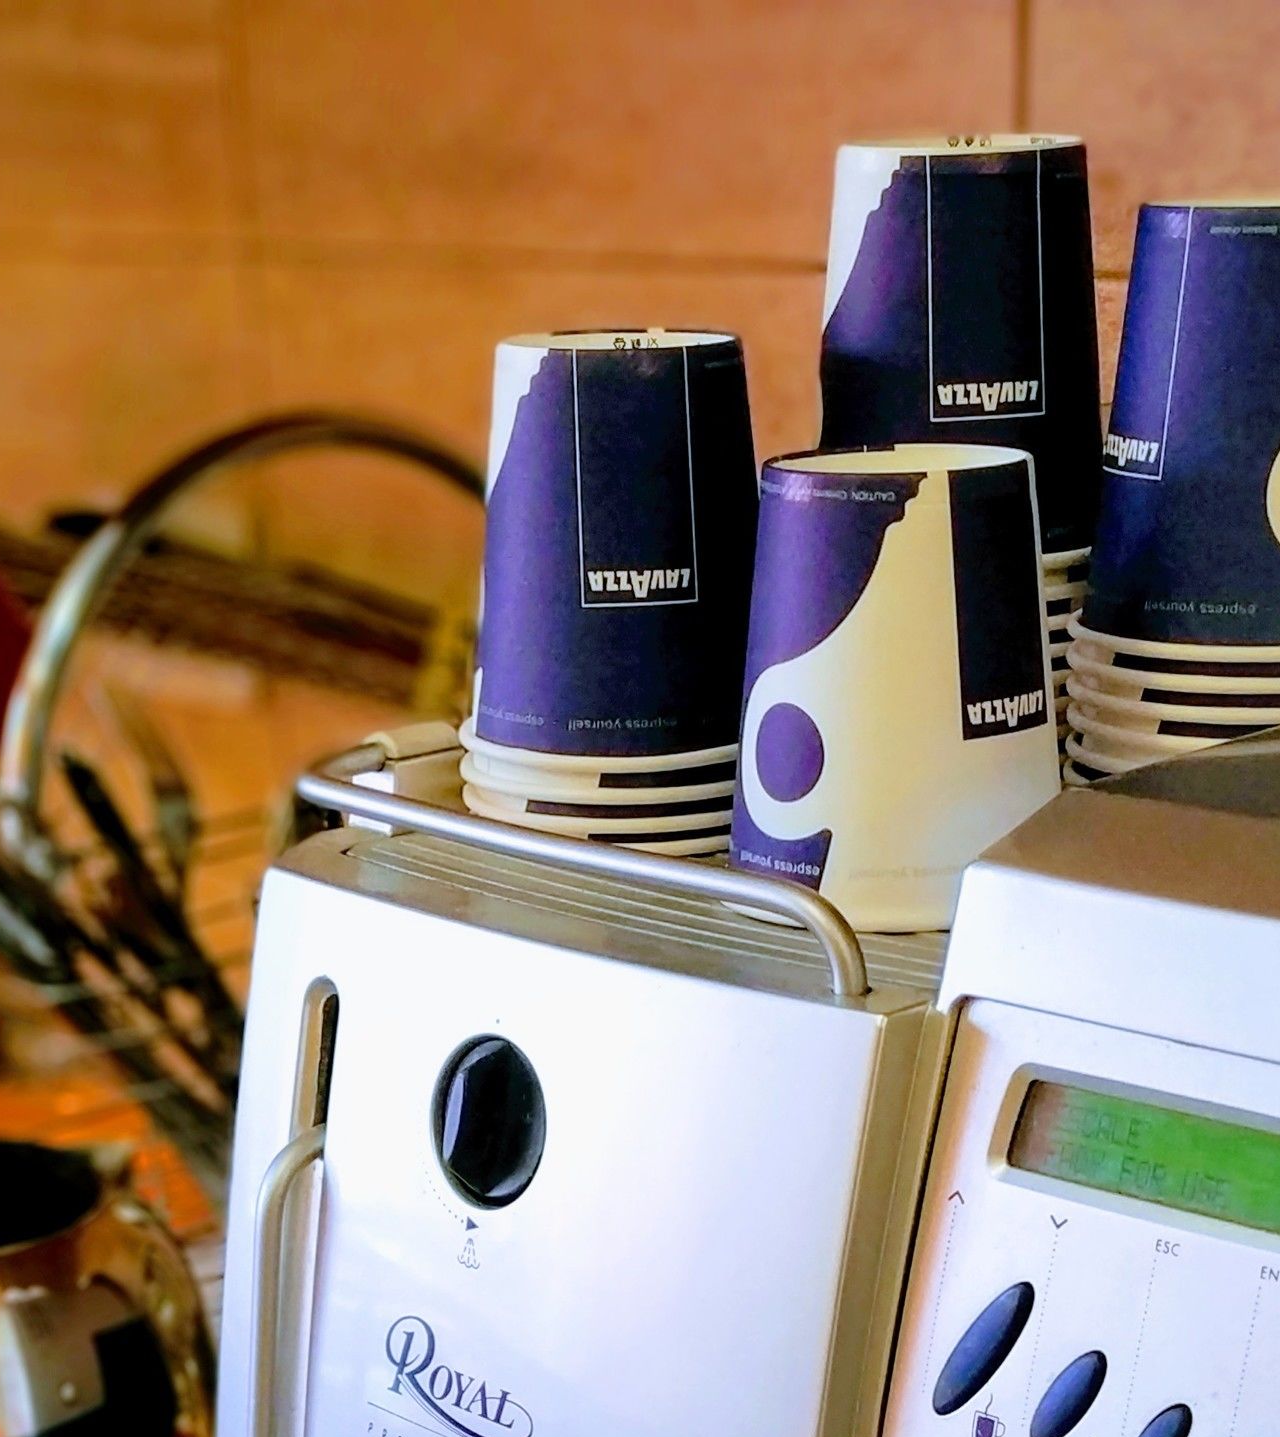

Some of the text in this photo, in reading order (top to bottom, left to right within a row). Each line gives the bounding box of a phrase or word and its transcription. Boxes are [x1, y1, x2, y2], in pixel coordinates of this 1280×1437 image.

[937, 379, 1039, 414] LAVAZZA
[851, 489, 897, 503] CAUTION
[586, 567, 692, 599] LAVAZZA
[966, 689, 1045, 727] LAVAZZA
[568, 717, 622, 732] yourself
[773, 858, 821, 877] espress
[1154, 1237, 1182, 1259] ESC
